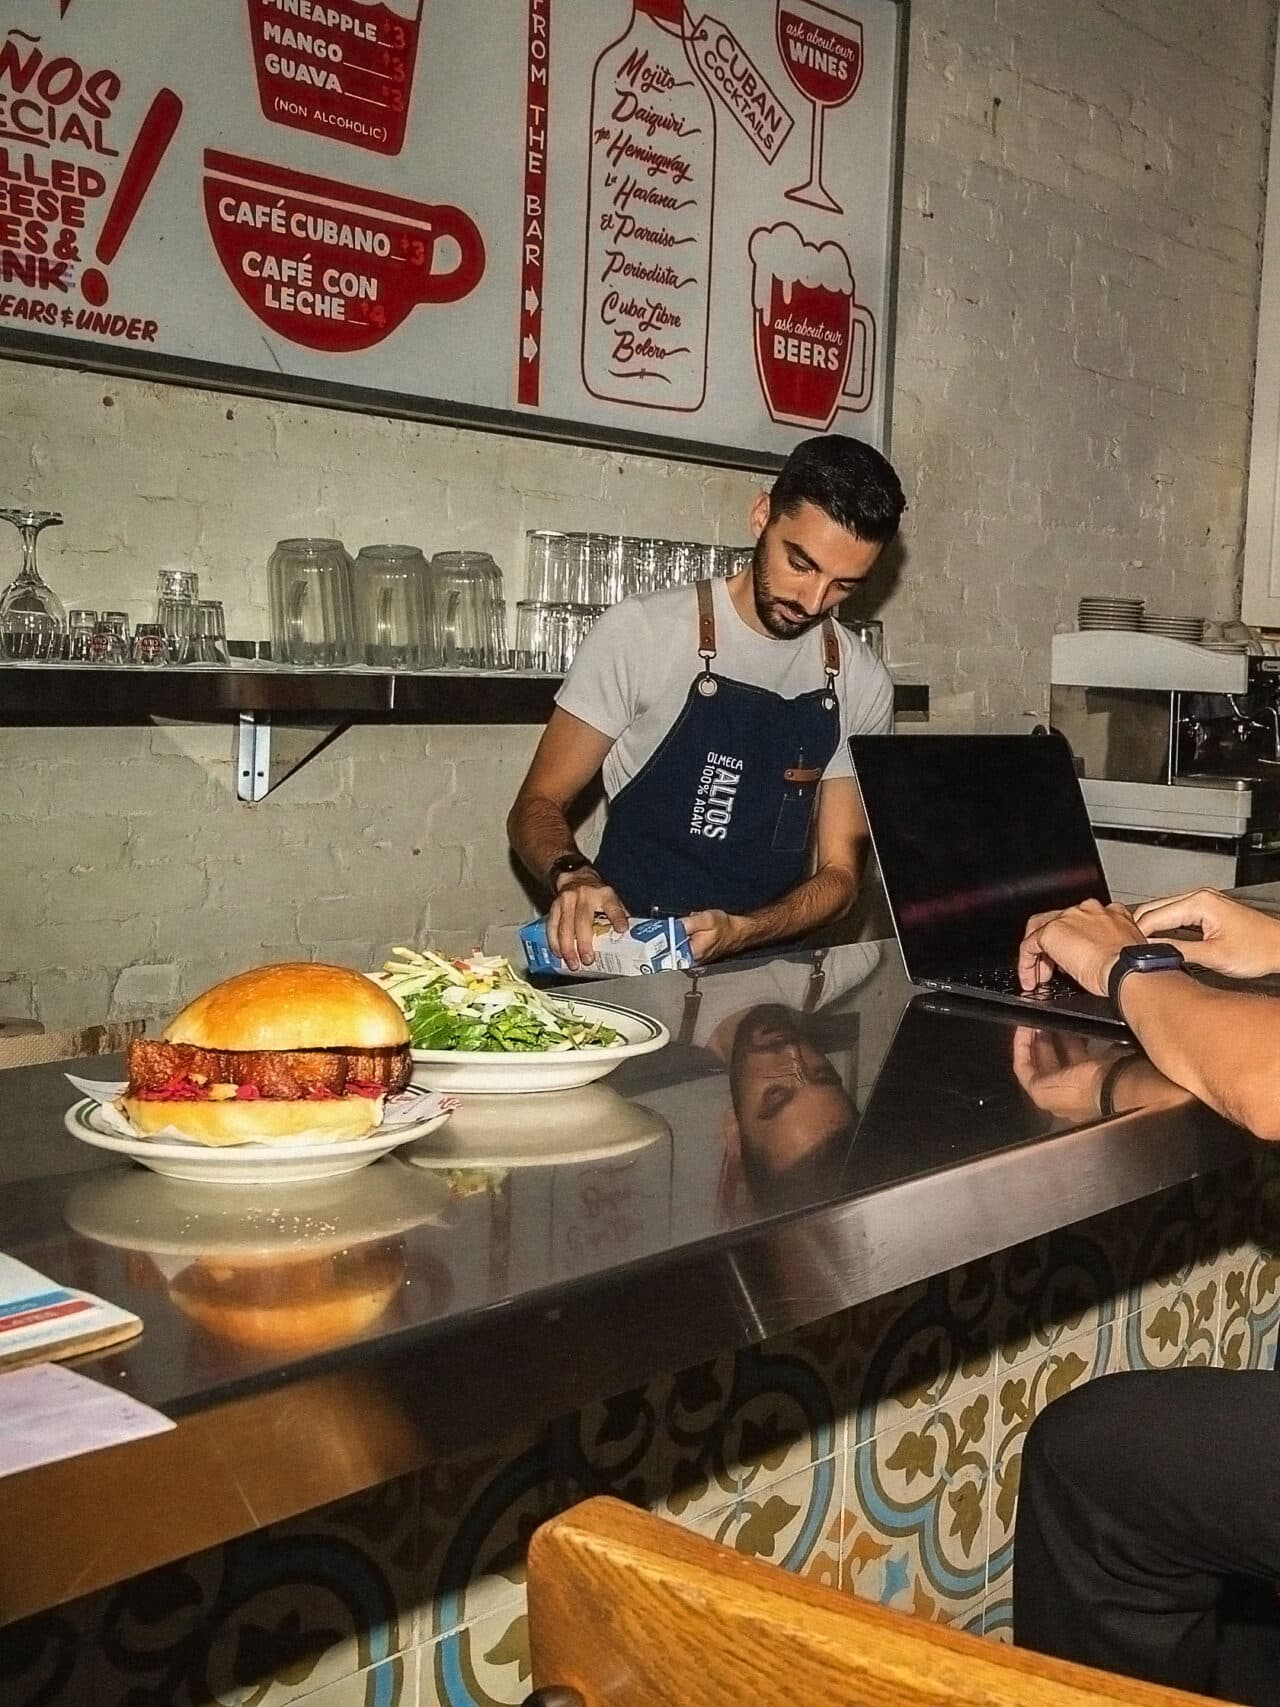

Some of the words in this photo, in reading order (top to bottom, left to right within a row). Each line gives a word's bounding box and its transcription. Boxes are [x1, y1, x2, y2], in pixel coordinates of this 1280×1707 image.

[263, 0, 377, 42] INEAPPLE
[263, 21, 343, 62] MANGO
[786, 22, 805, 40] ask
[806, 30, 836, 51] about
[835, 46, 855, 62] our
[789, 38, 848, 80] WINES
[264, 53, 343, 94] GUAVA
[617, 46, 694, 93] Mojito
[716, 34, 782, 132] CUBAN
[274, 96, 308, 118] (NON
[313, 110, 388, 142] ALCOHOLIC)
[611, 88, 702, 137] Daiquiri
[704, 51, 774, 150] COCKTAILS
[529, 104, 545, 174] THE
[606, 128, 694, 184] Hemingway
[604, 172, 617, 187] La
[613, 174, 697, 211] Havana
[53, 228, 82, 262] &
[218, 196, 287, 234] CAFÉ
[290, 213, 391, 257] CUBANO
[526, 195, 542, 266] BAR
[600, 214, 615, 231] El
[614, 211, 697, 248] Paraiso
[242, 251, 313, 287] CAFÉ
[323, 268, 378, 300] CON
[601, 249, 697, 289] Periodista
[265, 284, 345, 321] LECHE
[601, 290, 647, 325] Cuba
[638, 297, 681, 332] Libre
[75, 309, 159, 342] UNDER
[612, 328, 691, 363] Bolero
[774, 313, 794, 333] ask
[794, 317, 824, 340] about
[824, 330, 843, 346] our
[773, 334, 839, 371] BEERS
[697, 765, 716, 795] 100%
[707, 751, 743, 770] OLMECA
[690, 798, 707, 835] AGAVE
[702, 767, 741, 840] ALTOS
